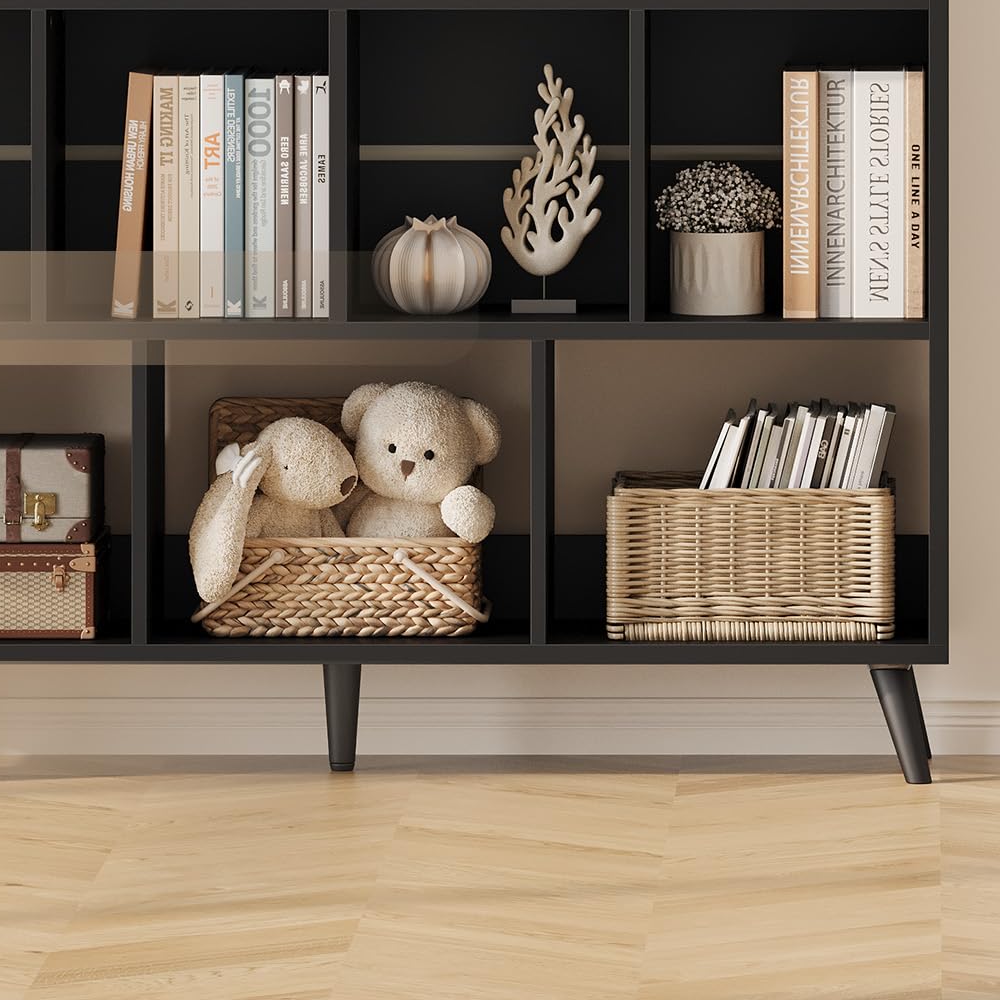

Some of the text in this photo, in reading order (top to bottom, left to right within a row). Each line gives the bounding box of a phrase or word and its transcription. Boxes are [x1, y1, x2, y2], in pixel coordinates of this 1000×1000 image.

[826, 79, 846, 287] INNENARCHITEKTUR
[911, 144, 921, 249] ONE LINE A DAY
